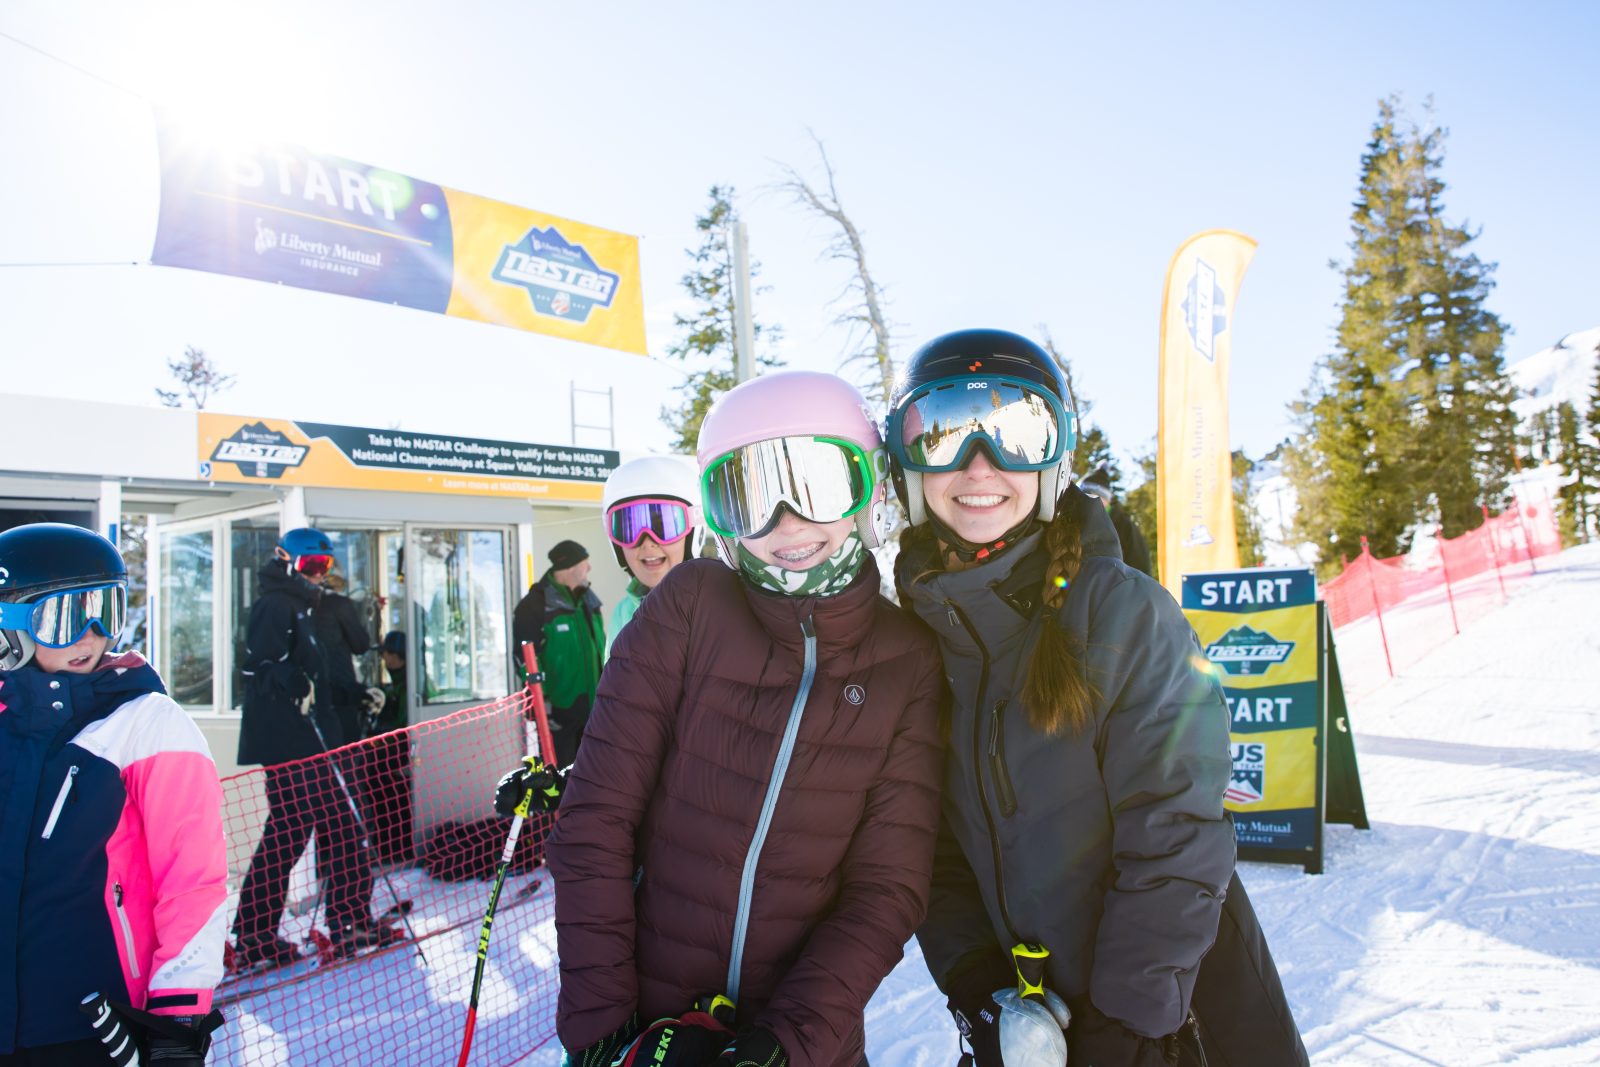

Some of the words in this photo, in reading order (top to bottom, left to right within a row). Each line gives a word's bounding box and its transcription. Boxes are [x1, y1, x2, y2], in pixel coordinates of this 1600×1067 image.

[231, 149, 398, 221] START
[281, 232, 331, 260] Liberty
[332, 244, 382, 266] Mutual
[300, 258, 359, 277] INSURANCE
[352, 449, 397, 463] National
[399, 452, 473, 470] Championships
[474, 459, 485, 469] at
[486, 459, 515, 473] Squaw
[516, 461, 542, 476] Valley
[543, 464, 570, 475] March
[368, 433, 392, 447] Take
[393, 436, 411, 449] the
[413, 438, 452, 453] NASTAR
[454, 442, 500, 458] Challenge
[500, 447, 511, 457] to
[512, 447, 542, 462] qualify
[543, 449, 556, 460] for
[557, 451, 572, 462] the
[573, 453, 605, 465] NASTAR
[1201, 578, 1292, 606] START
[1249, 819, 1291, 833] Mutual
[477, 915, 493, 960] LEKI
